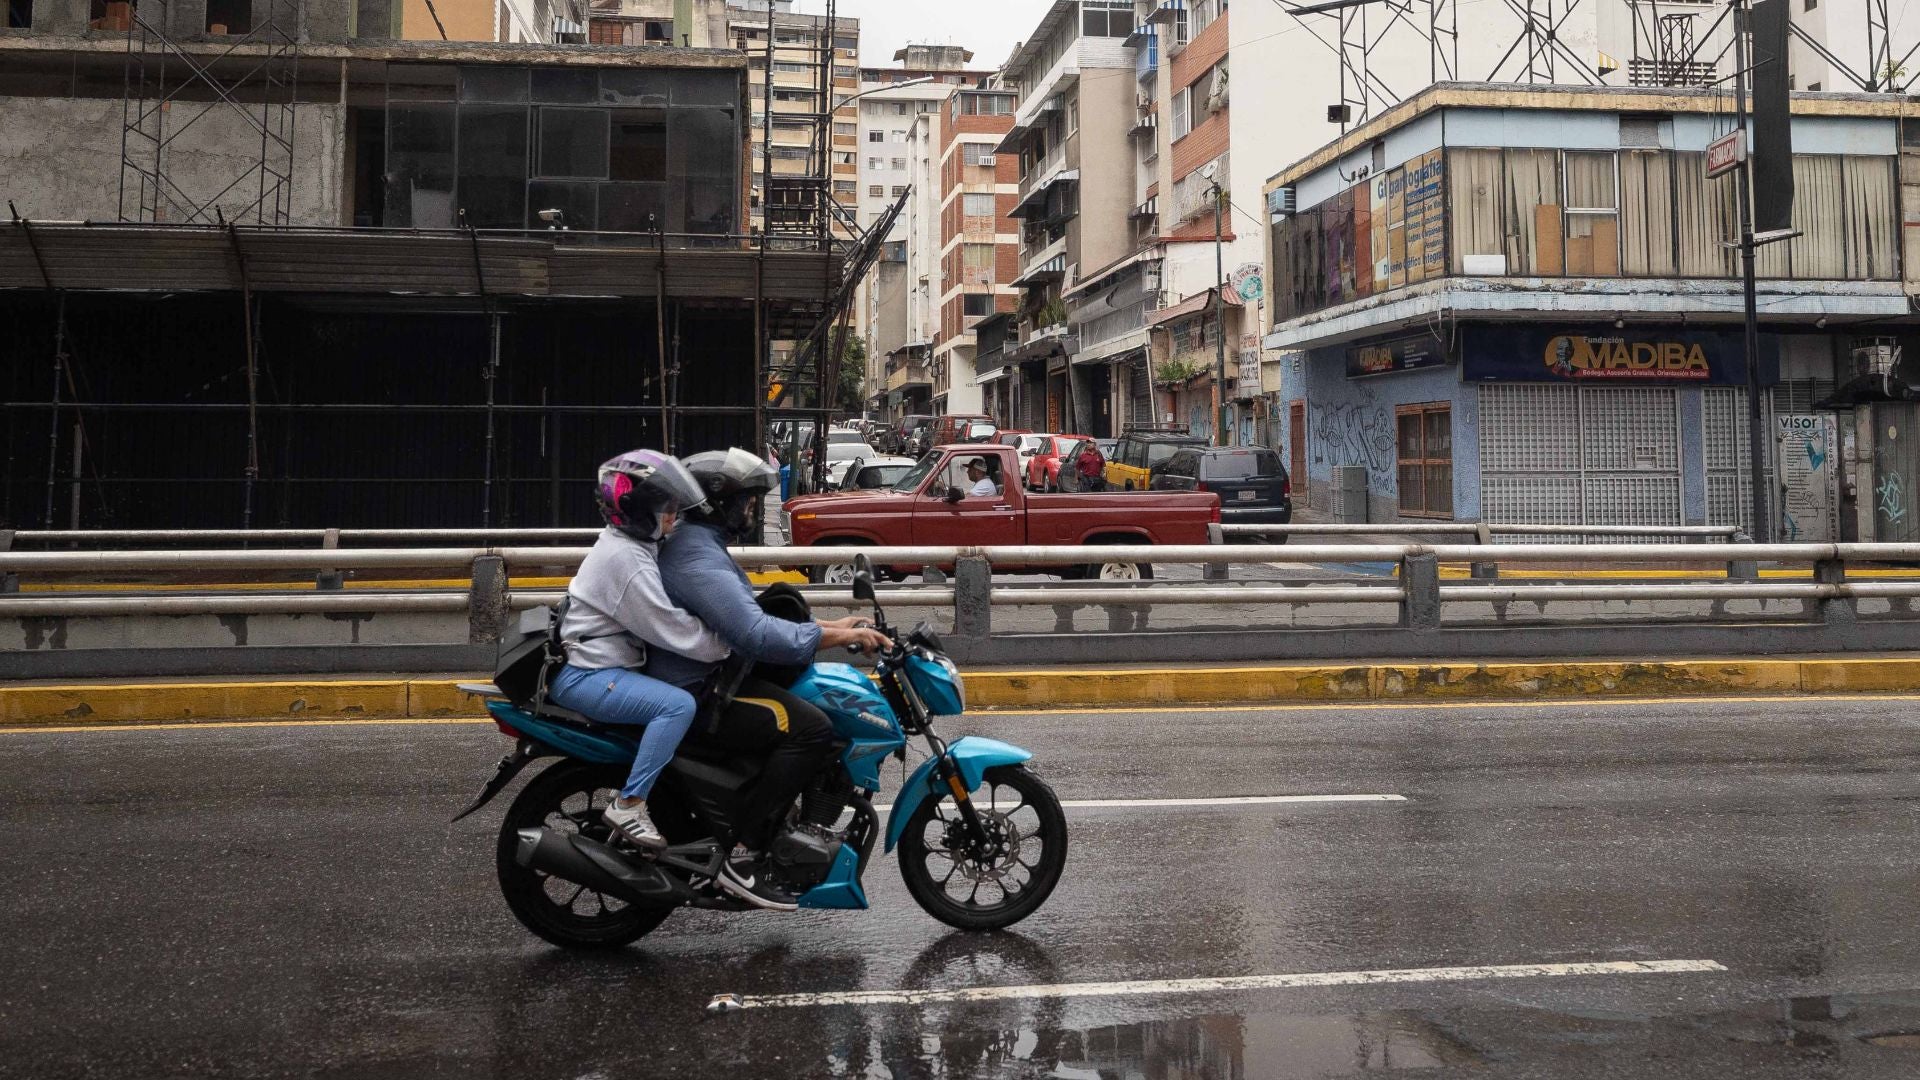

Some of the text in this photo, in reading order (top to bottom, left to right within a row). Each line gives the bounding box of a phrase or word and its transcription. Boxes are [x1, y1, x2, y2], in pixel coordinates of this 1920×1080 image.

[1709, 141, 1735, 169] FARMACIA
[1583, 336, 1625, 344] Fundación
[1584, 343, 1710, 369] MADIBA
[1780, 416, 1818, 429] visor
